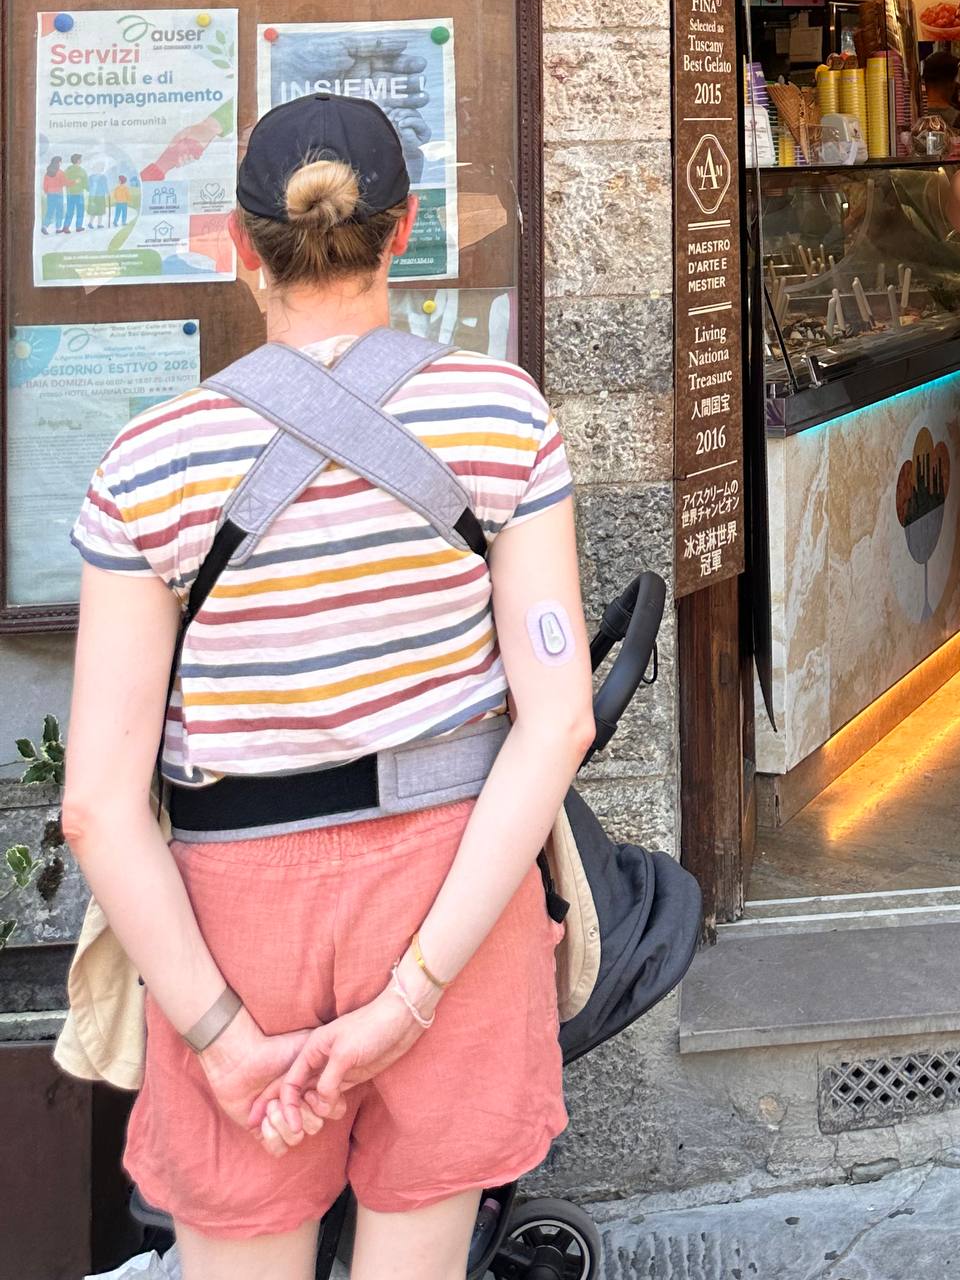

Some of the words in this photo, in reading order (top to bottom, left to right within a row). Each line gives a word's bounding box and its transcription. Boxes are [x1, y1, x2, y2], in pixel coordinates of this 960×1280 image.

[151, 29, 205, 42] auser
[689, 18, 715, 33] Selected
[716, 25, 725, 34] as
[50, 43, 140, 65] Servizi
[688, 34, 724, 58] Tuscany
[683, 55, 702, 72] Best
[704, 56, 731, 73] Gelato
[50, 66, 136, 87] Sociali
[142, 75, 152, 85] e
[157, 71, 173, 84] di
[50, 88, 223, 108] Accompagnamento
[694, 83, 722, 105] 2015
[49, 117, 88, 128] Insieme
[90, 119, 107, 130] per
[110, 118, 119, 127] la
[121, 116, 167, 127] comunità
[688, 239, 731, 255] MAESTRO
[688, 259, 720, 275] D'ARTE
[721, 257, 728, 270] E
[688, 276, 726, 293] MESTIER
[694, 326, 727, 344] Living
[108, 361, 158, 374] ESTIVO
[688, 369, 733, 391] Treasure
[690, 393, 731, 420] 人間国宝
[695, 425, 726, 455] 2016
[682, 479, 739, 511] アイスクリームの
[681, 496, 740, 529] 世界チャンピオン
[700, 549, 723, 577] 冠軍
